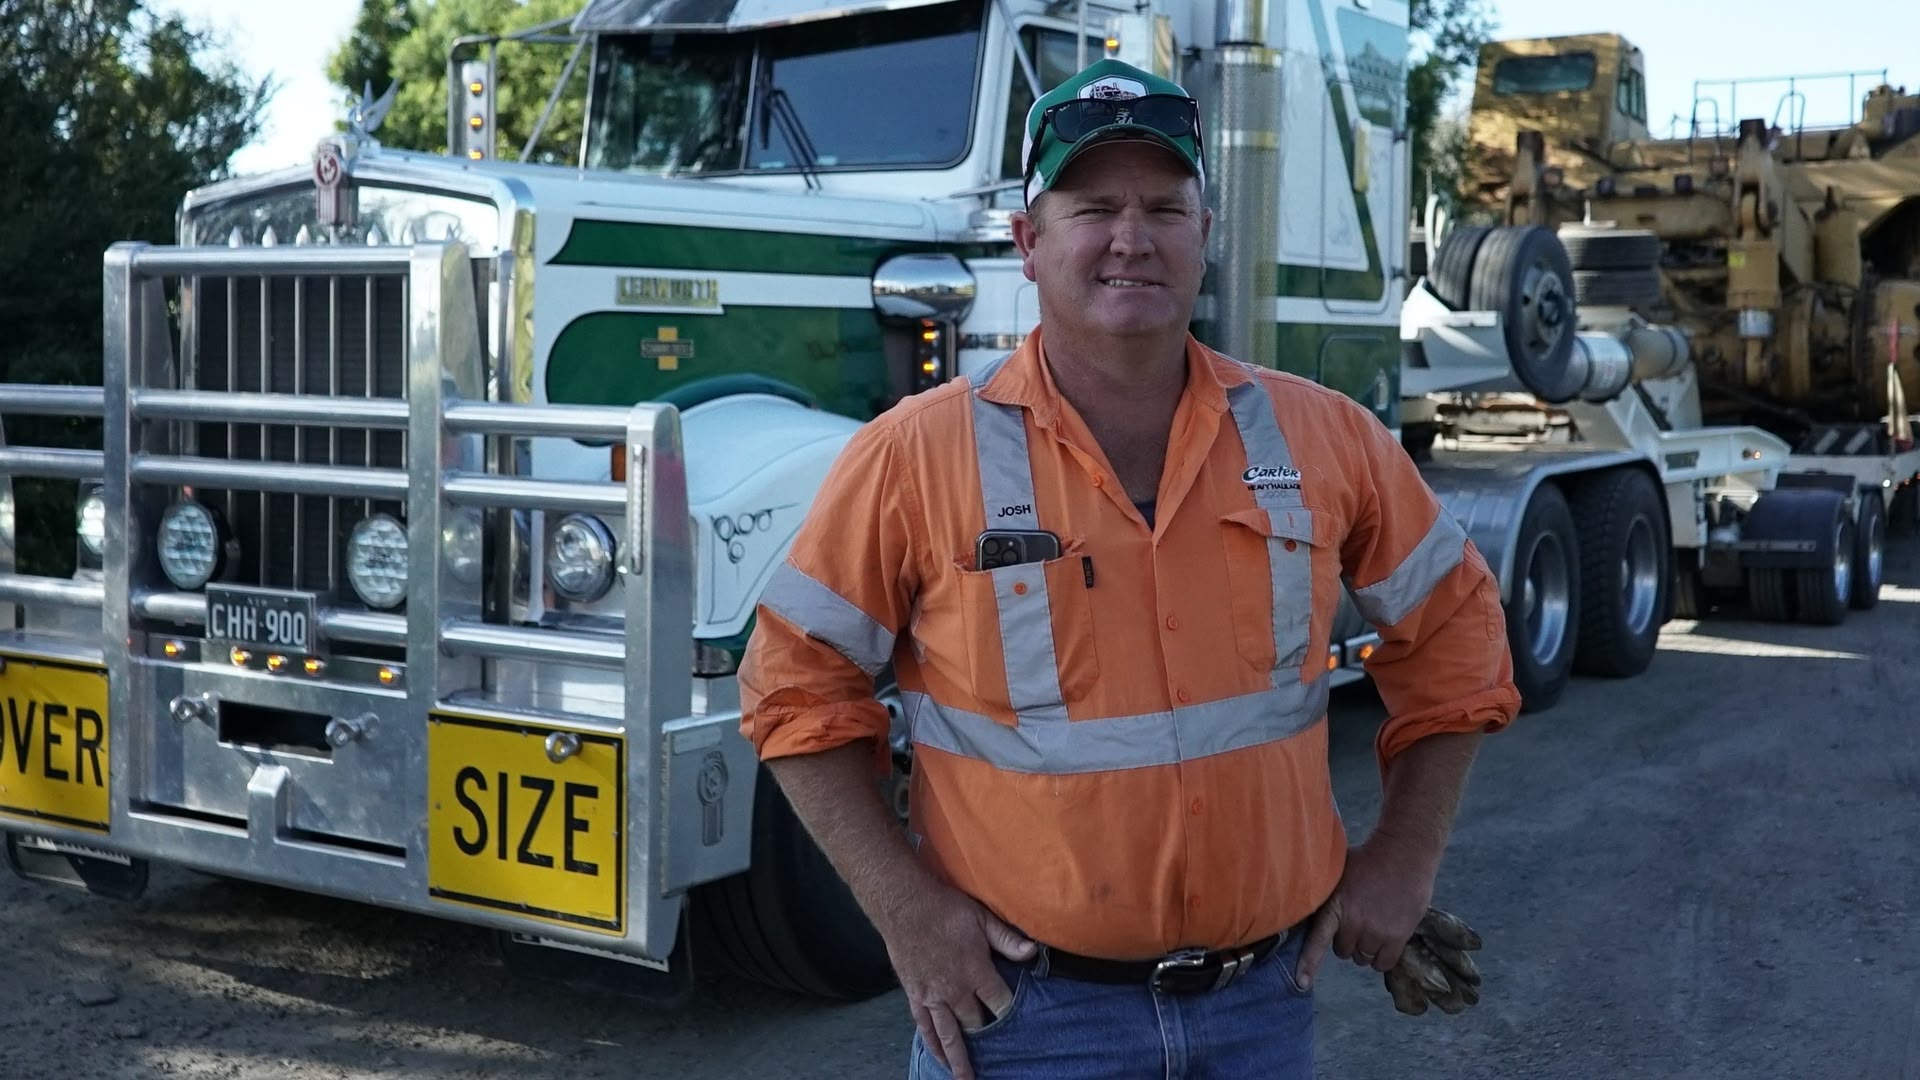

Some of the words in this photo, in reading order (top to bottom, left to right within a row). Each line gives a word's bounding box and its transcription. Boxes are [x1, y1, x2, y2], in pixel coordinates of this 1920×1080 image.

[997, 504, 1032, 518] JOSH
[265, 608, 307, 646] 900
[0, 697, 104, 788] VER
[453, 766, 599, 877] SIZE
